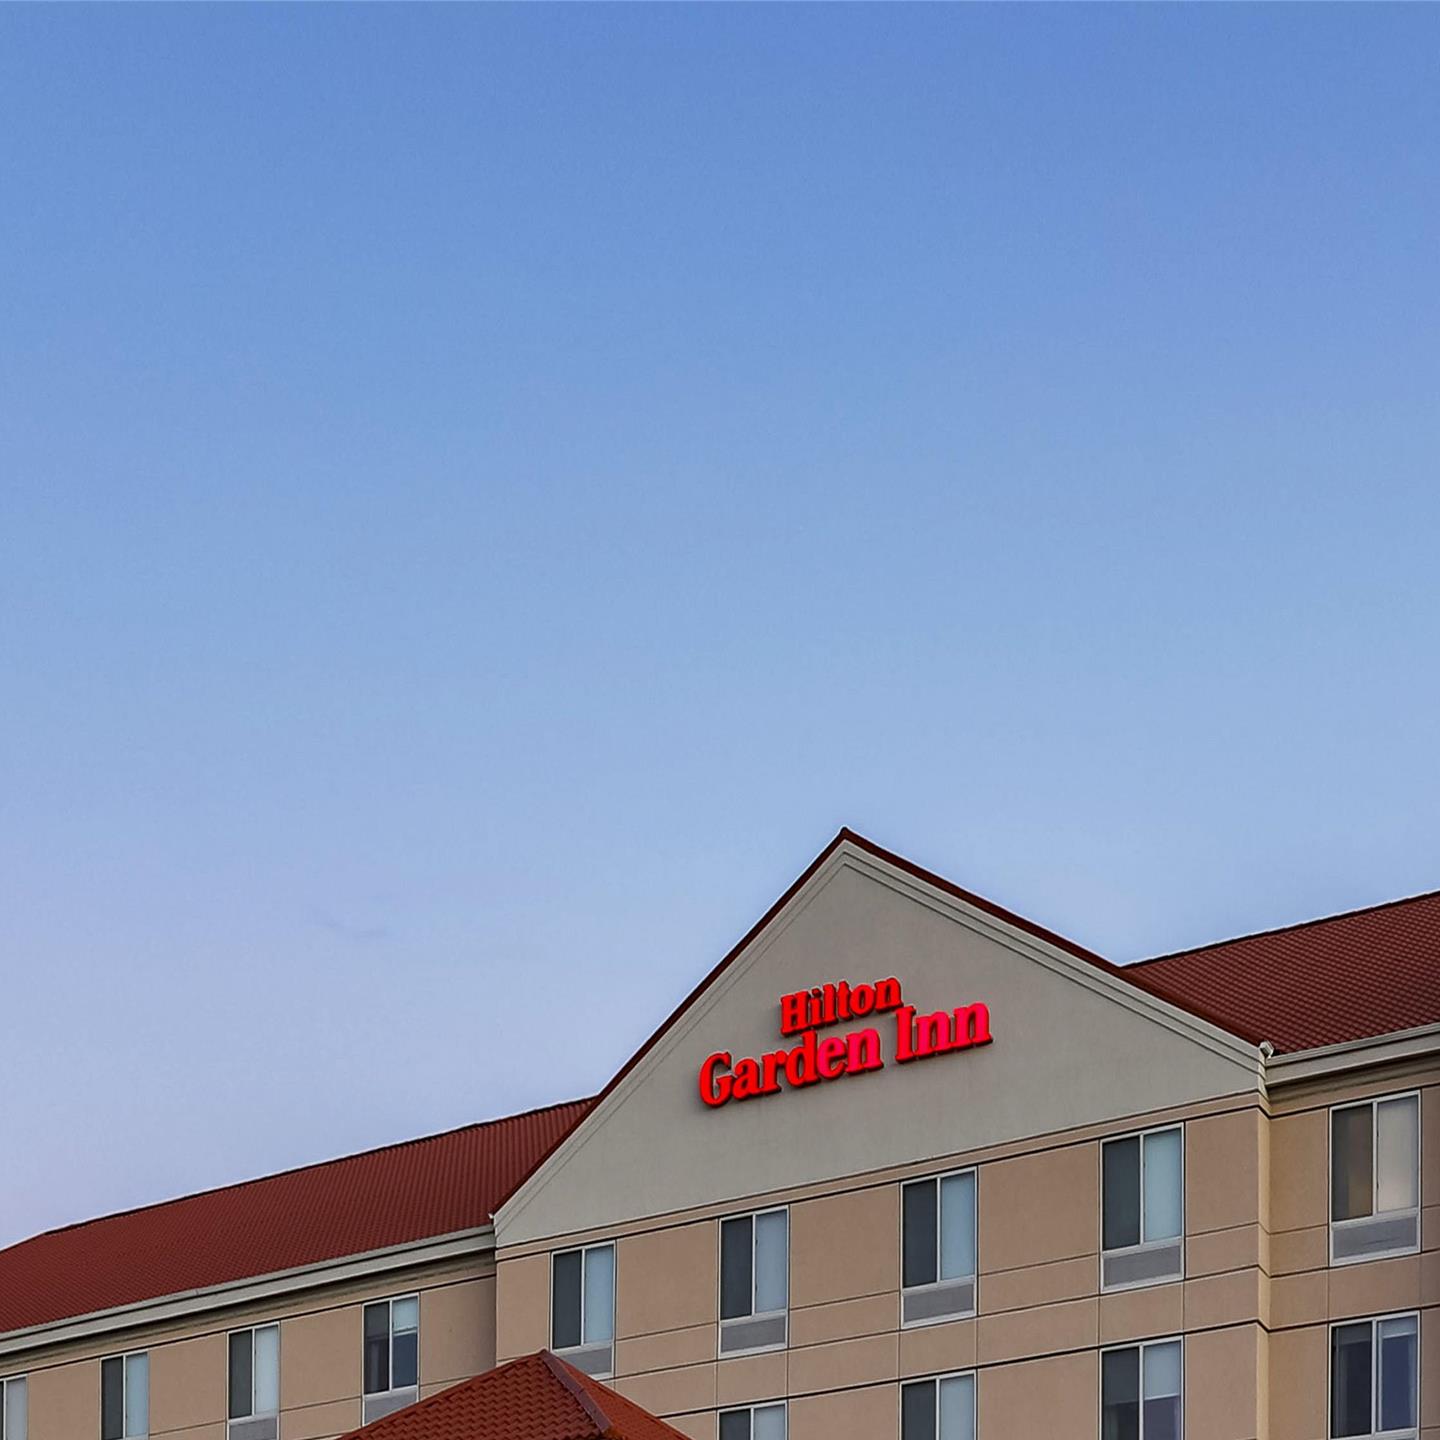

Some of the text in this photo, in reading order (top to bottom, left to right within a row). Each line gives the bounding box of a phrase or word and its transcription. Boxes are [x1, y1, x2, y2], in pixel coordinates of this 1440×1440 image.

[780, 975, 904, 1037] Hilton
[698, 1002, 993, 1108] Garden Inn
